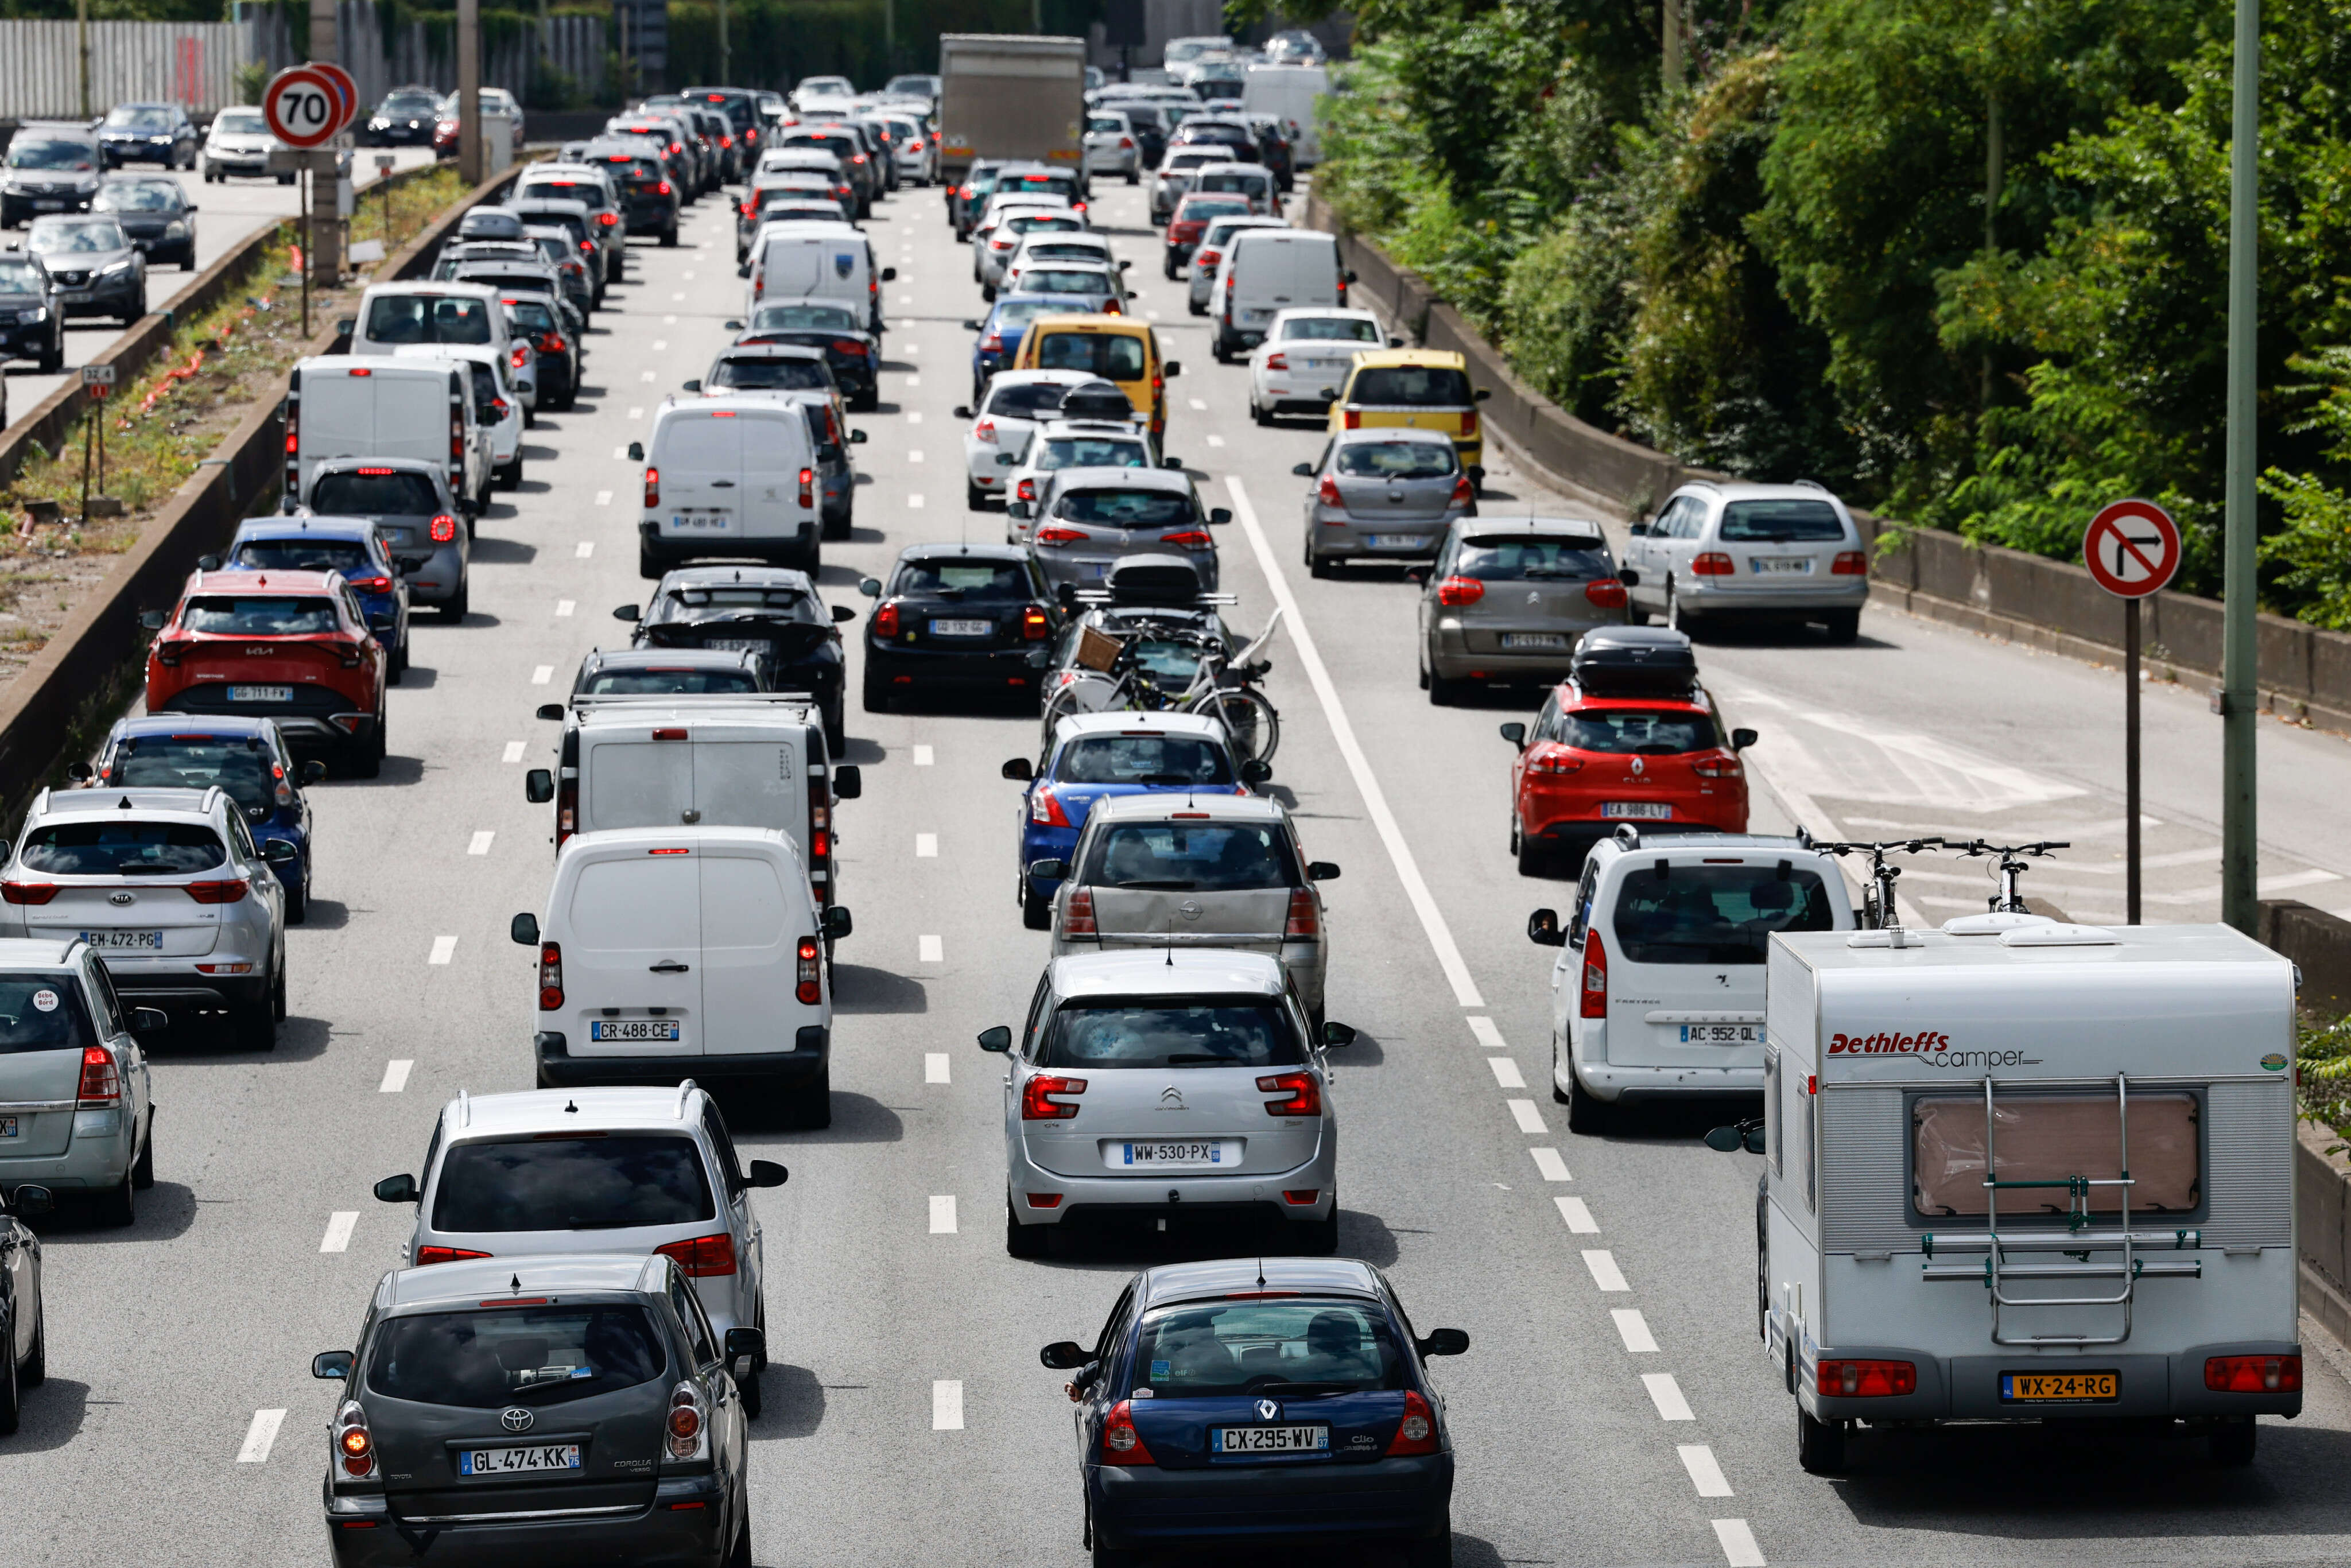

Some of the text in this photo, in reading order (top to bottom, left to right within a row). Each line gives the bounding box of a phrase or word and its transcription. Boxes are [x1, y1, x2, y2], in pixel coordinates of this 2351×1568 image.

[283, 93, 325, 125] 70
[249, 808, 264, 816] C1
[90, 933, 154, 946] EM-472-PG
[601, 1023, 669, 1038] CR-488-CE
[1690, 1027, 1756, 1041] AC-952-QL
[1828, 1031, 1949, 1054] Dethleffs
[1935, 1050, 2024, 1070] camper
[1135, 1144, 1209, 1161] WW-530-PX
[2020, 1377, 2111, 1395] WX-24-RG
[1225, 1429, 1314, 1449] CX-295-WV
[1318, 1438, 1328, 1447] 37
[1352, 1435, 1374, 1443] Clio
[474, 1447, 567, 1472] GL-474-KK
[569, 1457, 579, 1465] 75
